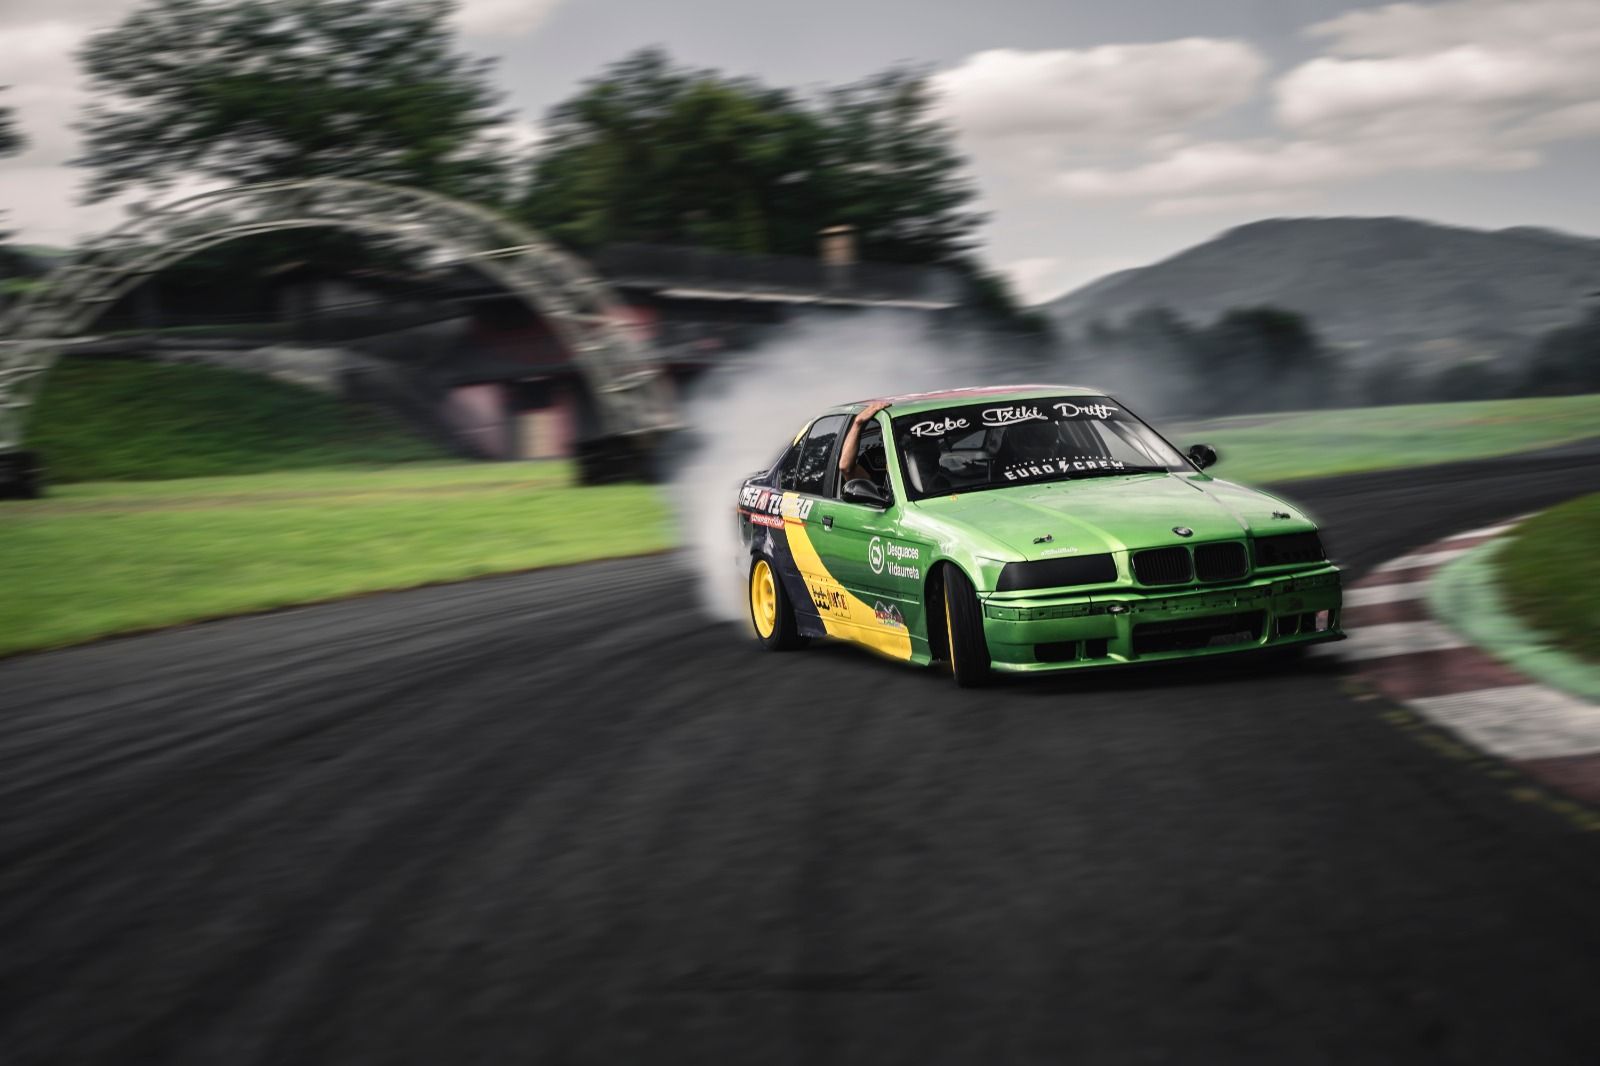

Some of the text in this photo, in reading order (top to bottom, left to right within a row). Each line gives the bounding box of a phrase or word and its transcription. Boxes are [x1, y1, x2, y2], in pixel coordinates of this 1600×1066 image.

[910, 402, 1119, 438] Rebe Txiki Drift
[1003, 463, 1056, 481] EURO
[1072, 460, 1125, 470] CREW
[886, 541, 919, 561] Desguaces
[886, 561, 920, 580] Vidaurreta
